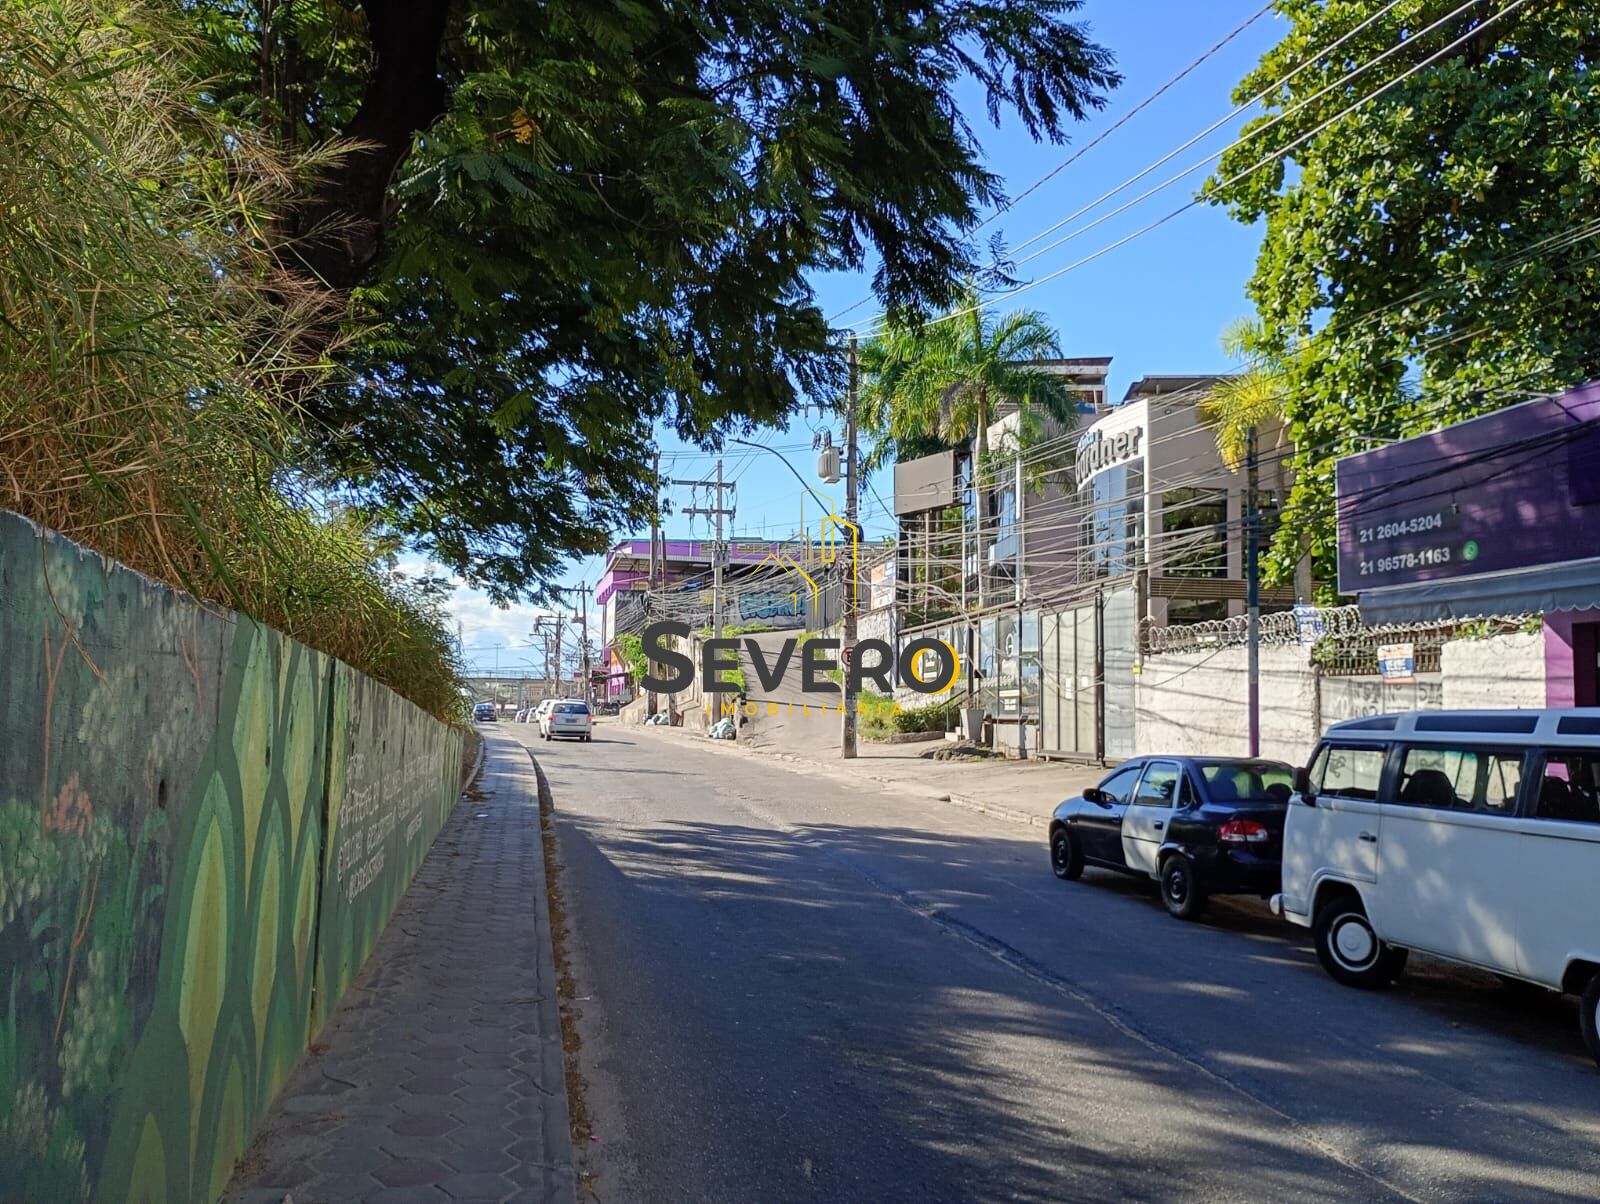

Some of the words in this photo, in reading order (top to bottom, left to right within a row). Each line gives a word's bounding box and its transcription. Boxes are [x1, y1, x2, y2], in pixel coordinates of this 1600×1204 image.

[1359, 528, 1374, 543] 21
[1377, 513, 1441, 539] 2604-5204
[1359, 560, 1374, 576] 21
[1377, 547, 1450, 573] 96578-1163
